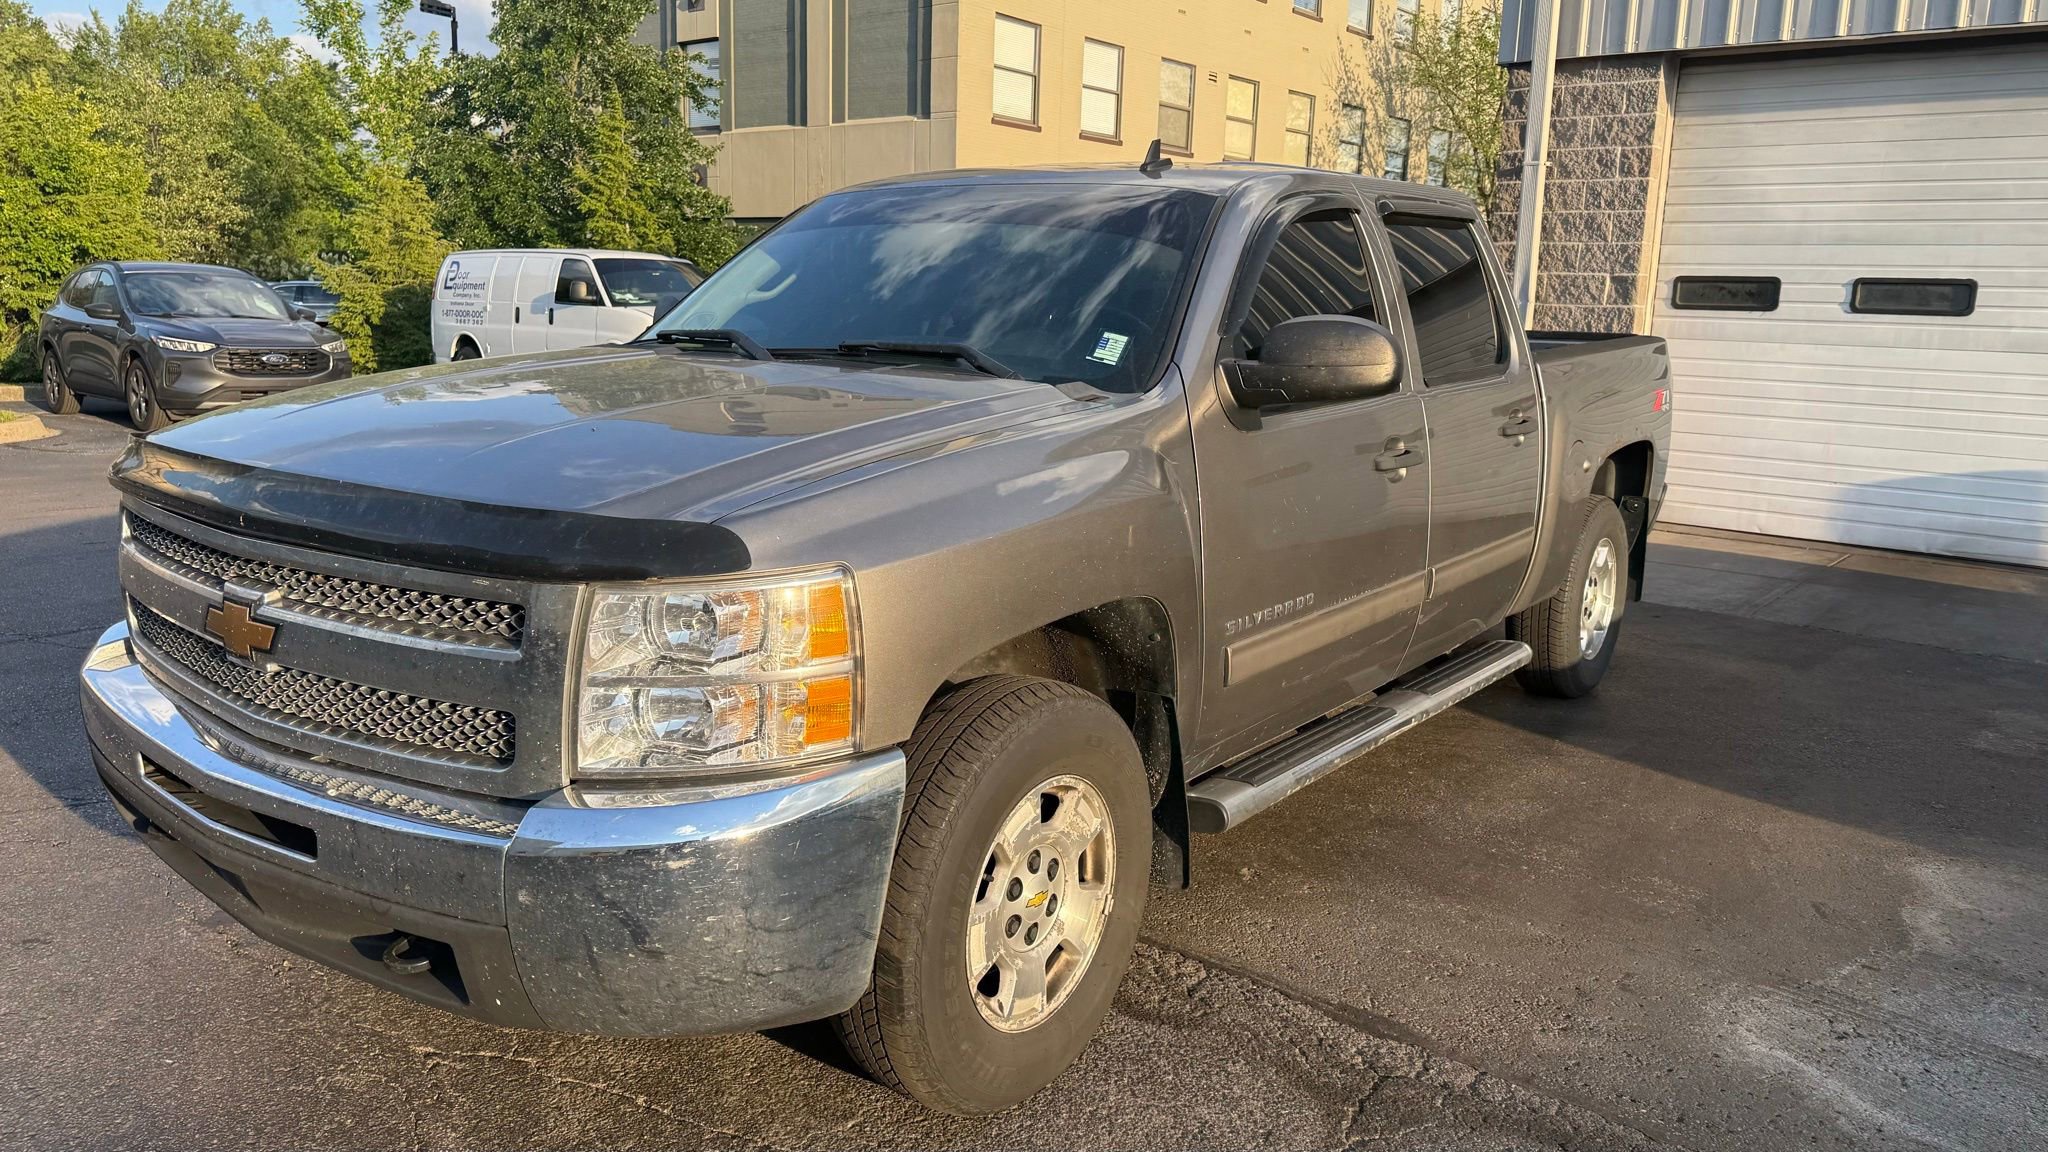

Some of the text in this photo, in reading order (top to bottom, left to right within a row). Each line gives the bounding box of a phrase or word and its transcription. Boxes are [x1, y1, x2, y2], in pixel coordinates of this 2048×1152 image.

[444, 270, 485, 292] Equipment
[449, 261, 470, 281] Door
[442, 309, 483, 318] 1-877-DOOR-DOC
[1225, 592, 1314, 635] SILVERADO
